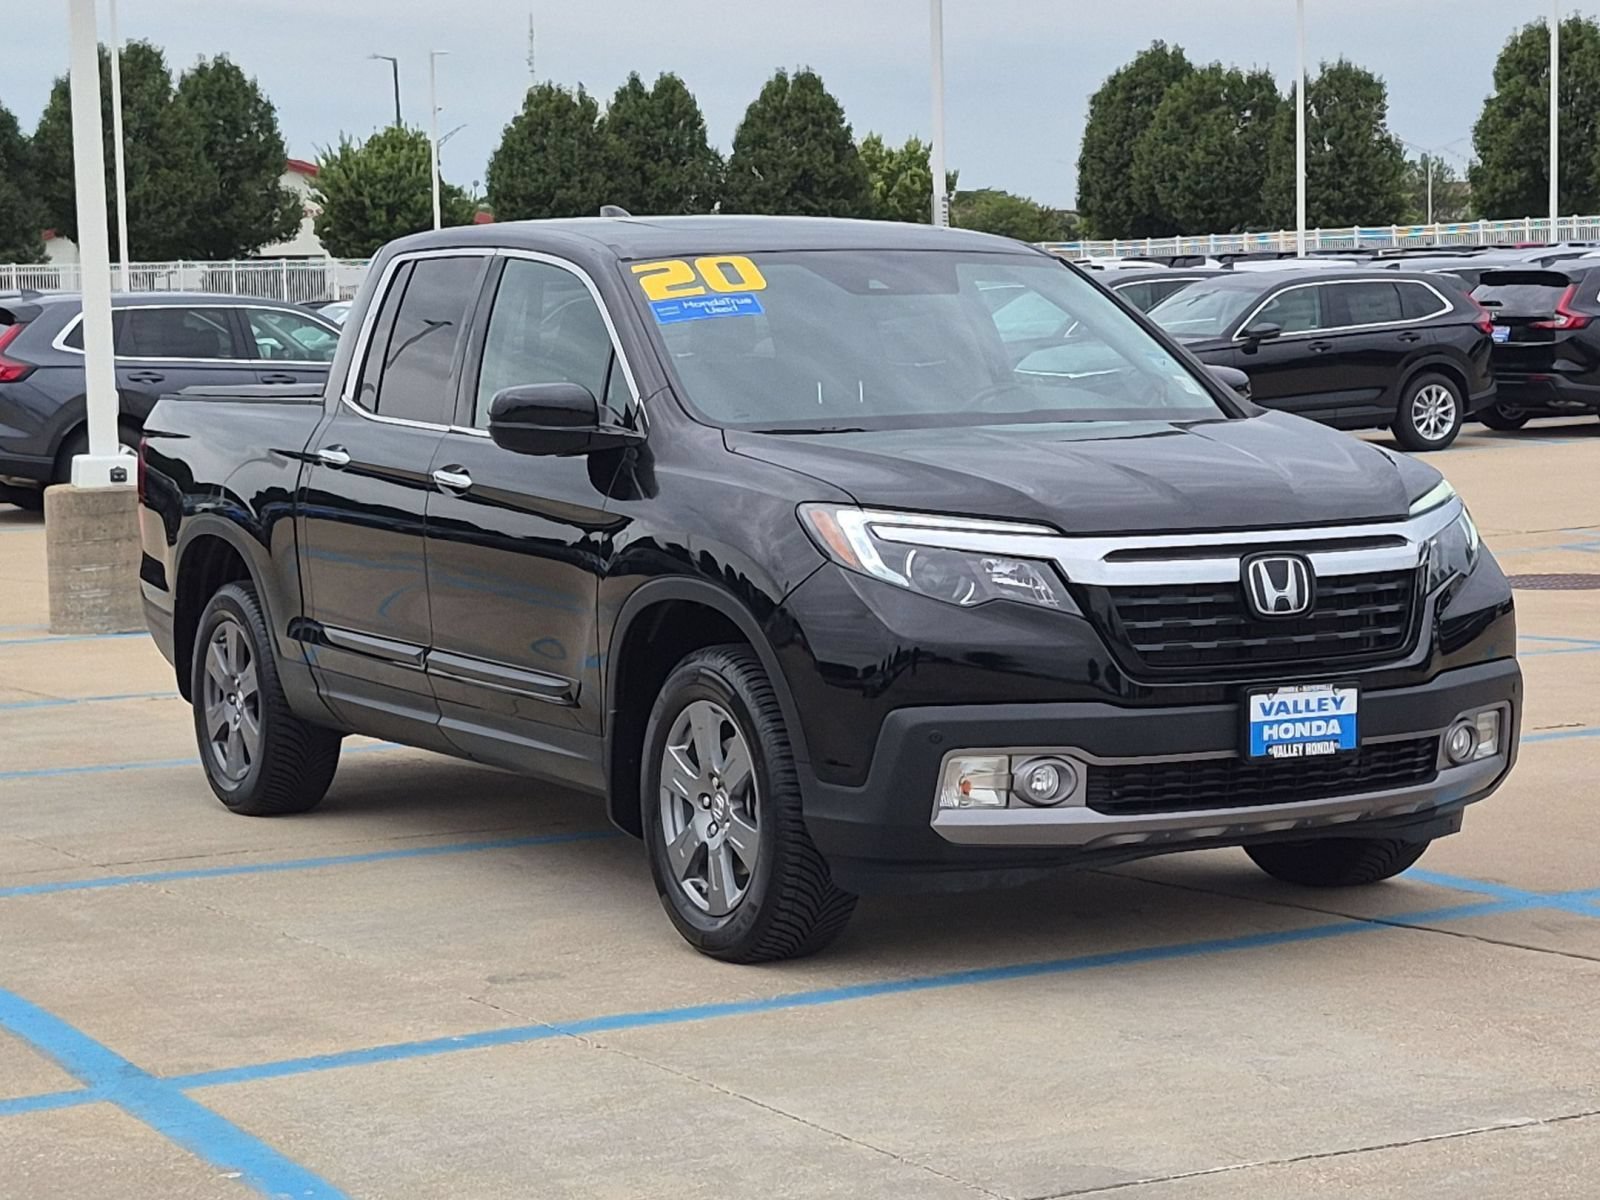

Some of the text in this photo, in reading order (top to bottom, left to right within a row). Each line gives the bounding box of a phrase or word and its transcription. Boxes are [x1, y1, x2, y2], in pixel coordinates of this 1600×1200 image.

[631, 256, 767, 300] 20
[704, 304, 738, 314] Used
[1259, 696, 1347, 717] VALLEY
[1263, 718, 1342, 742] HONDA
[1272, 740, 1336, 759] VALLEY HONDA
